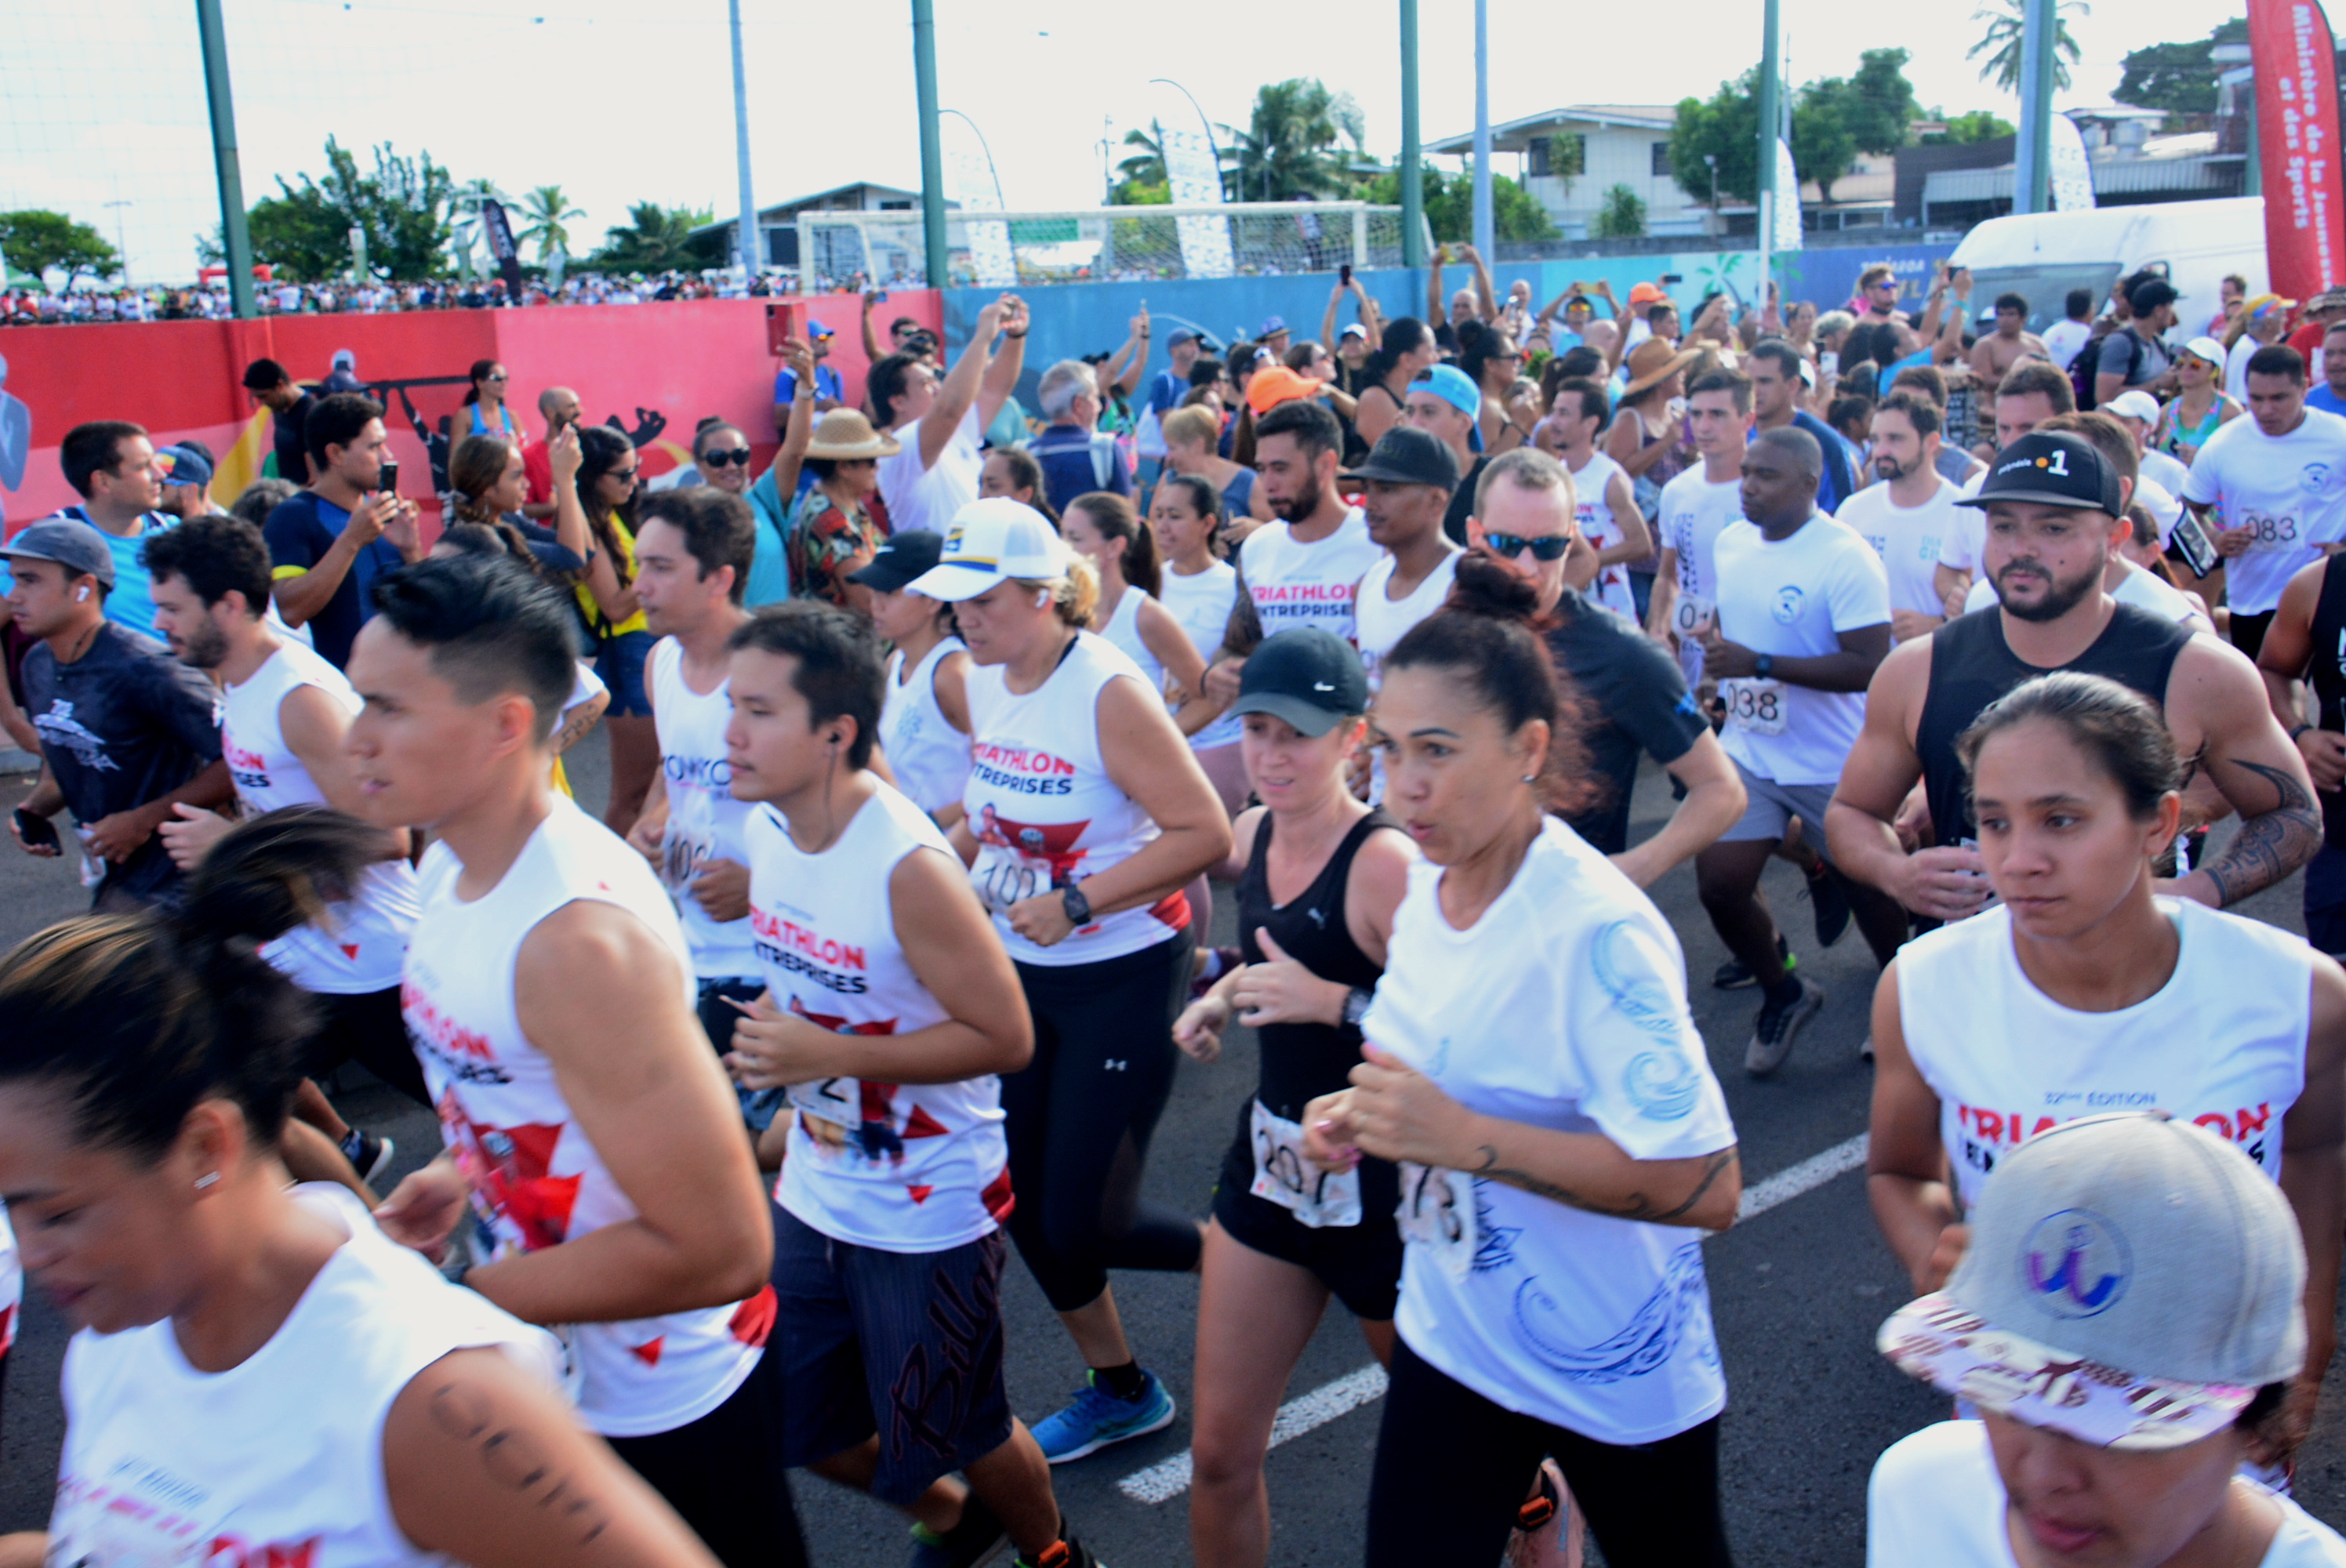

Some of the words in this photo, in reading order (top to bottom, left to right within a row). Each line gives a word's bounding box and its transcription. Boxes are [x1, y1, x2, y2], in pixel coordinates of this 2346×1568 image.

[2292, 4, 2319, 117] Ministère
[2279, 77, 2297, 101] et
[2283, 107, 2301, 150] des
[2305, 124, 2325, 154] de
[2285, 156, 2310, 229] Sports
[2047, 449, 2069, 477] 1
[1959, 1102, 2271, 1145] TRIAON
